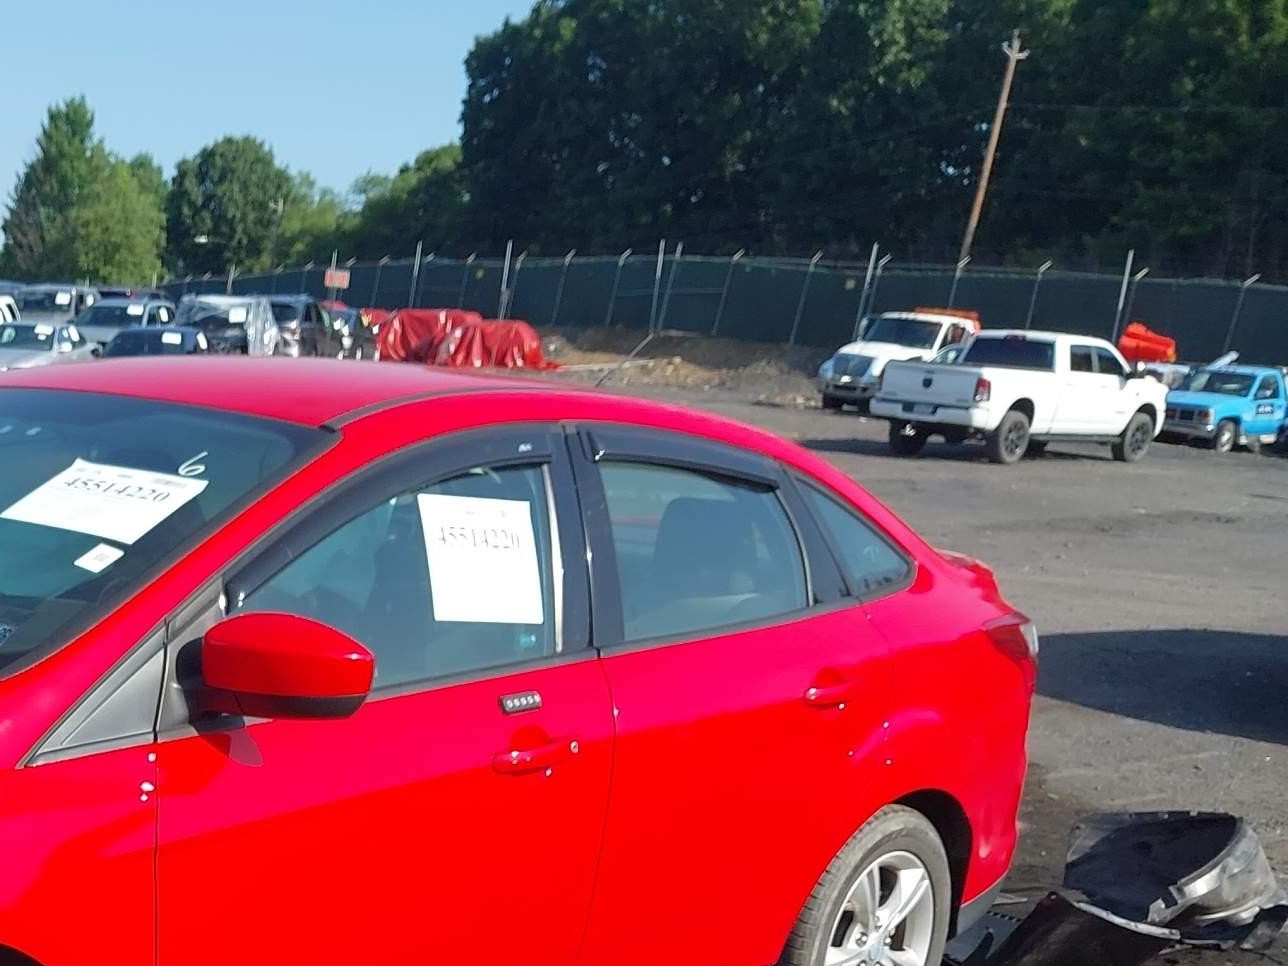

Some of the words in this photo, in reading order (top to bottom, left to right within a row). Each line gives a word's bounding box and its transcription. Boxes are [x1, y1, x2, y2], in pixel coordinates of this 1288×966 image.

[177, 451, 209, 476] 6
[64, 477, 171, 503] 45514220
[439, 525, 521, 550] 45514220
